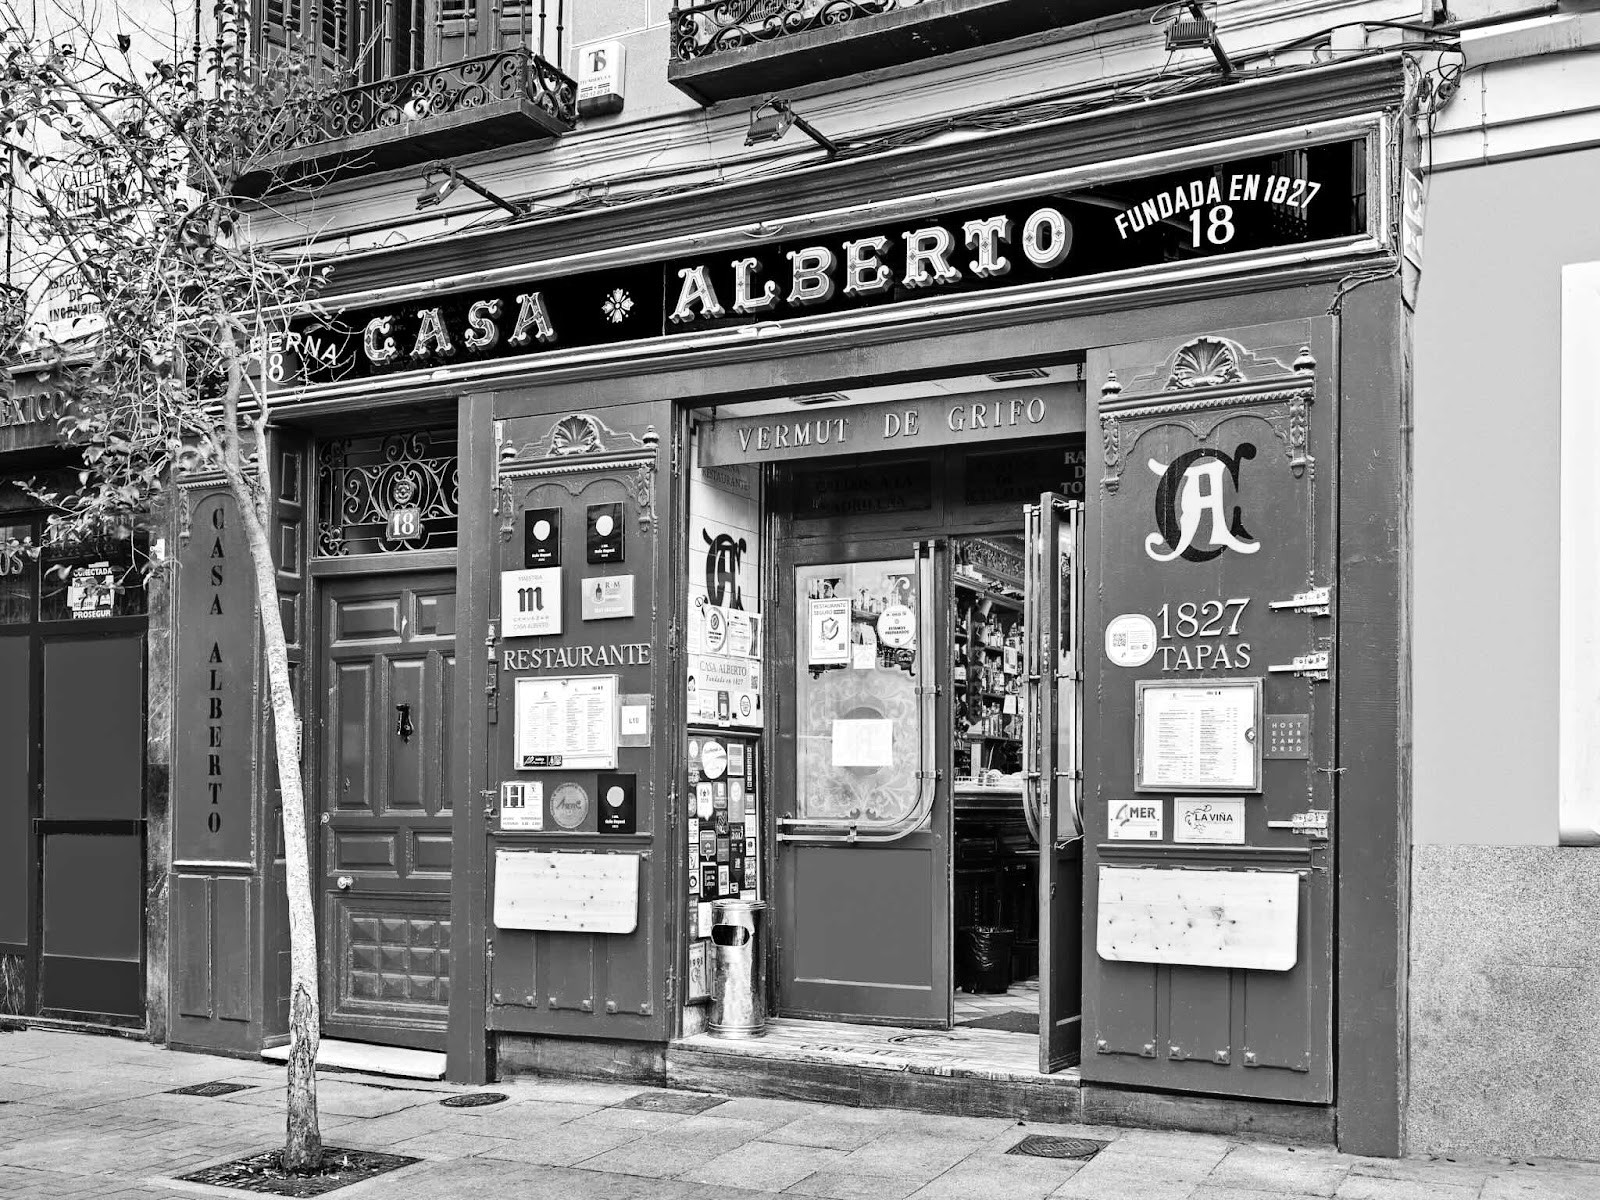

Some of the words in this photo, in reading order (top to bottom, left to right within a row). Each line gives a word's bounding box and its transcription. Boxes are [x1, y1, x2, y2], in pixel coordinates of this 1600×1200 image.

[1114, 176, 1222, 239] FUNDADA
[1229, 174, 1260, 201] EN
[1263, 175, 1321, 209] 1827
[1189, 204, 1235, 248] 18
[362, 292, 556, 366] CASA
[669, 207, 1072, 324] ALBERTO
[737, 418, 849, 451] VERMUT
[883, 410, 919, 438] DE
[948, 398, 1046, 431] GRIFO
[393, 512, 415, 536] 18
[209, 507, 225, 616] CASA
[73, 610, 111, 620] PROSEGUR
[1156, 598, 1251, 640] 1827
[503, 642, 651, 671] RESTAURANTE
[1156, 643, 1251, 671] TAPAS
[207, 641, 224, 834] ALBERTO
[505, 785, 524, 808] H
